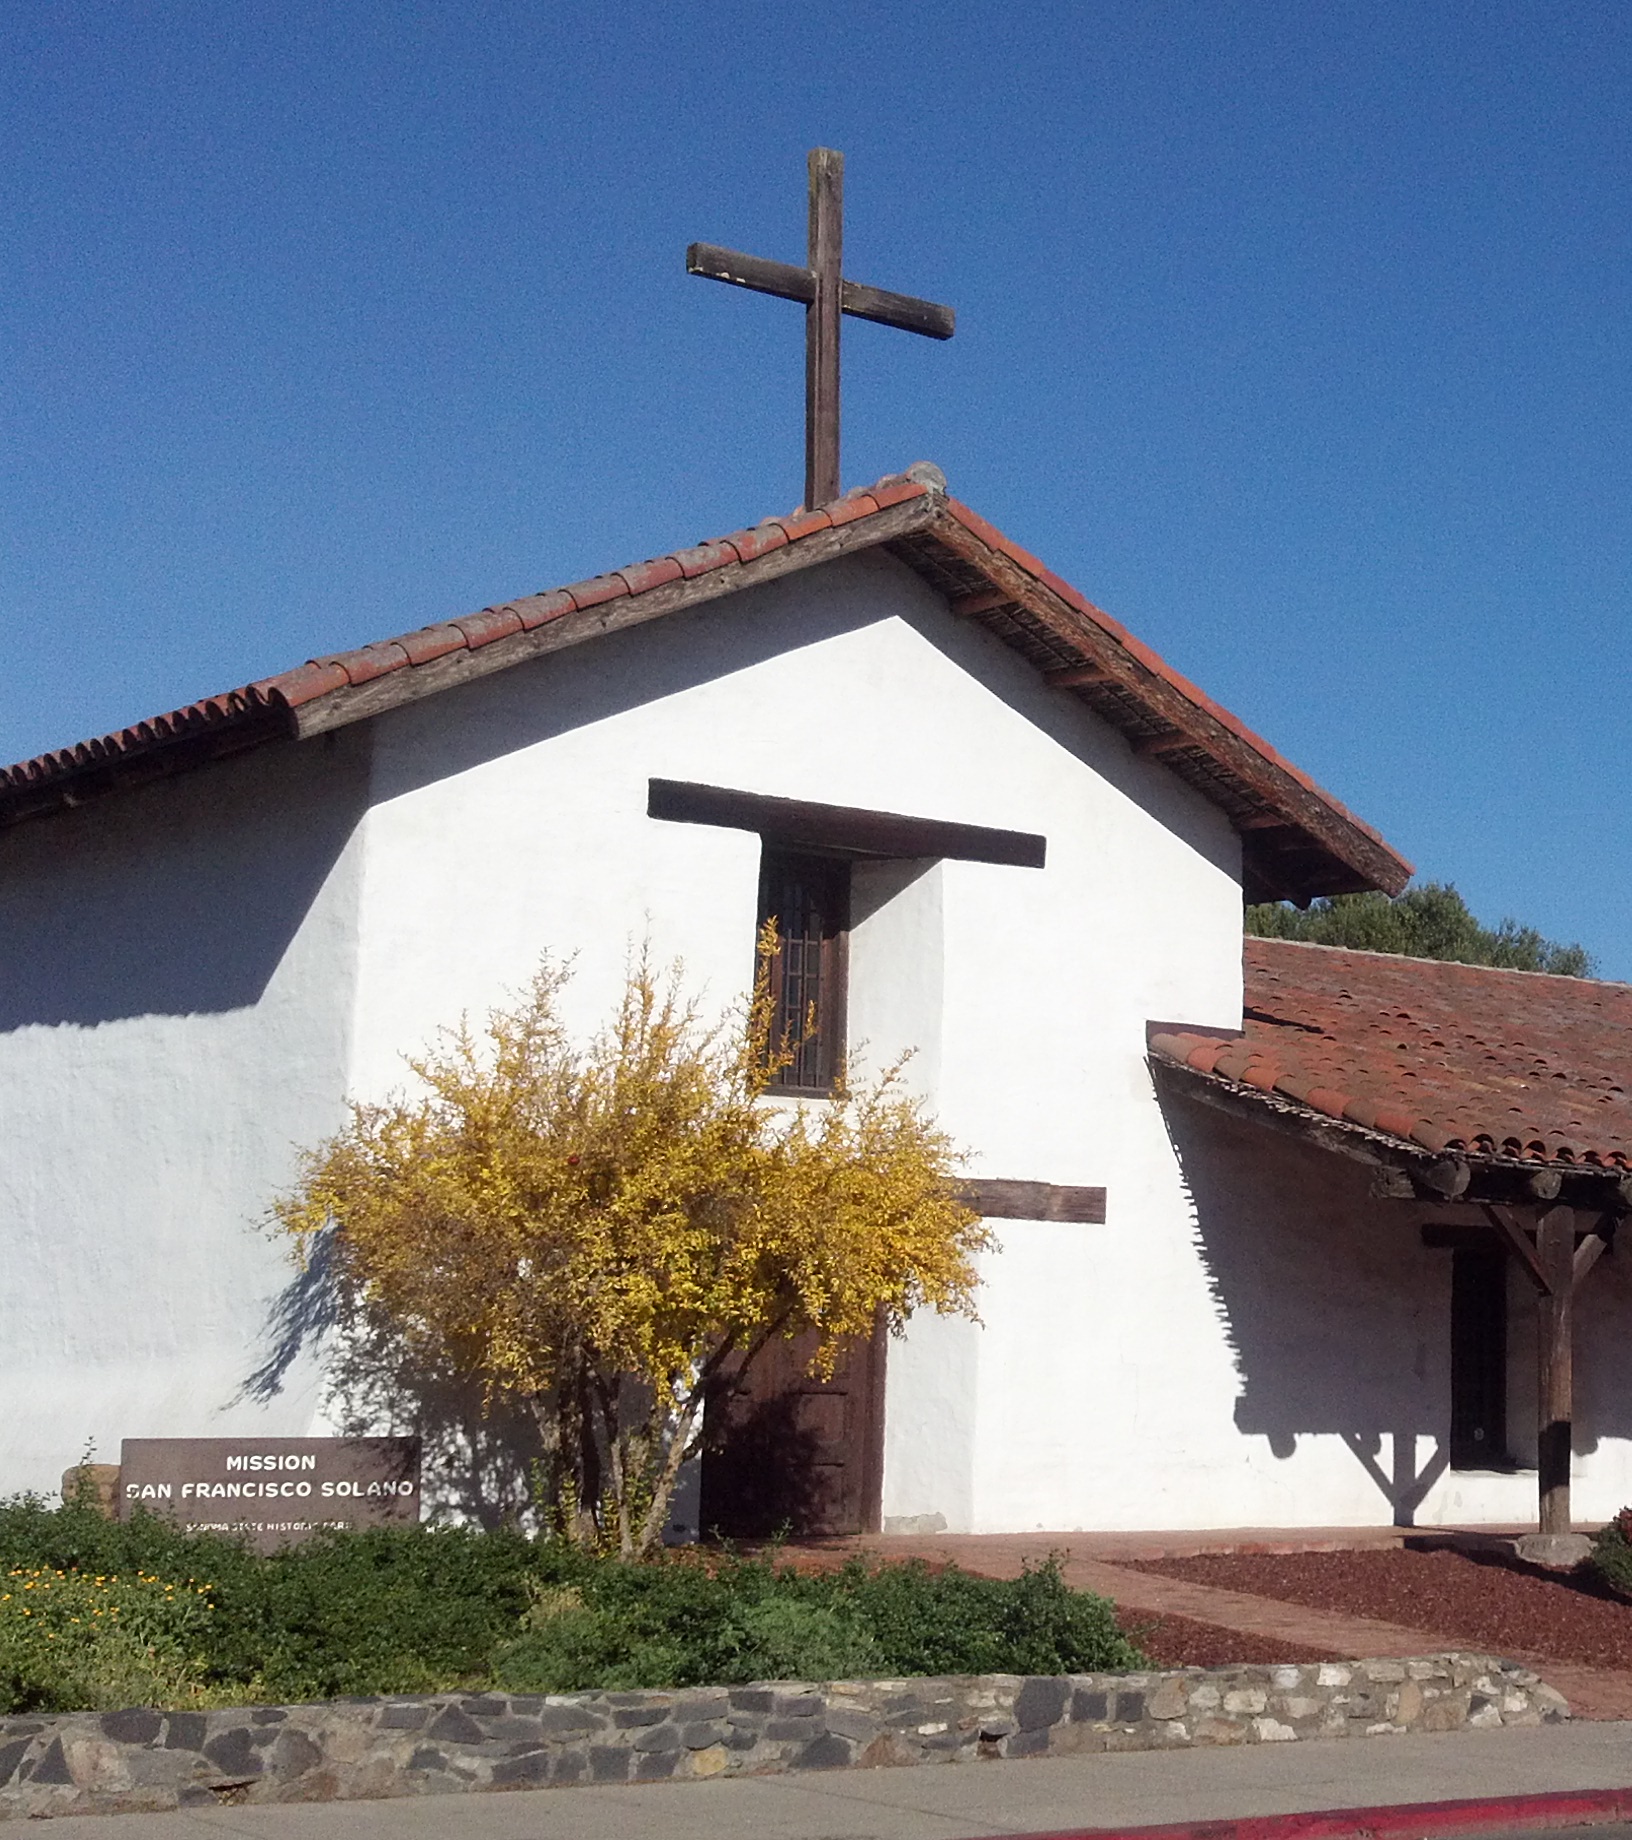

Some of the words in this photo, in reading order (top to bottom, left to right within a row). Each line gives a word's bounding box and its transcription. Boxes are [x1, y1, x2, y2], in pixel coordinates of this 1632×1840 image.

[226, 1455, 316, 1471] MISSION
[126, 1483, 172, 1499] SAN
[181, 1481, 312, 1499] FRANCISCO
[321, 1480, 414, 1497] SOLANO
[186, 1522, 229, 1532] SNOMA
[322, 1521, 353, 1531] PAR
